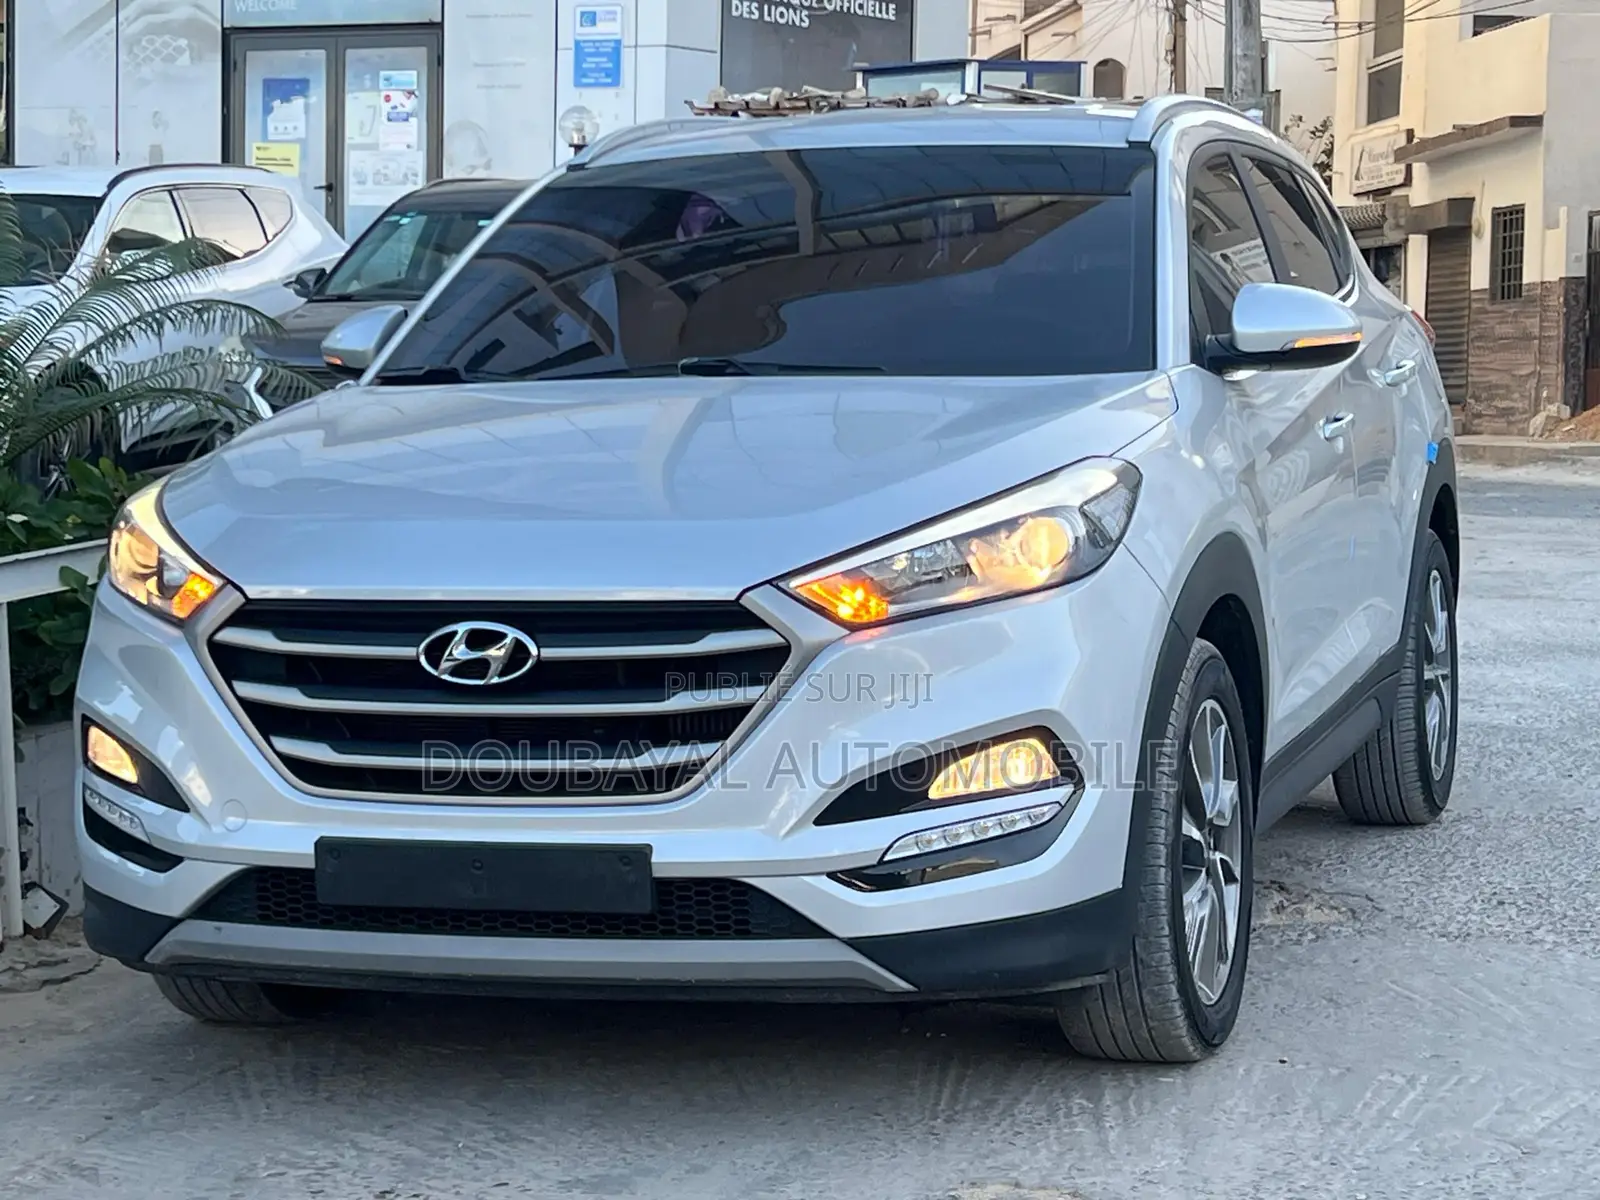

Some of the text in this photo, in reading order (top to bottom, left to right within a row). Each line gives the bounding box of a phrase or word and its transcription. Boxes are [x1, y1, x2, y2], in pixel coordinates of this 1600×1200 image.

[234, 0, 297, 12] WELCOME
[731, 0, 810, 28] DES LIONS
[823, 0, 897, 21] OFFICIELLE
